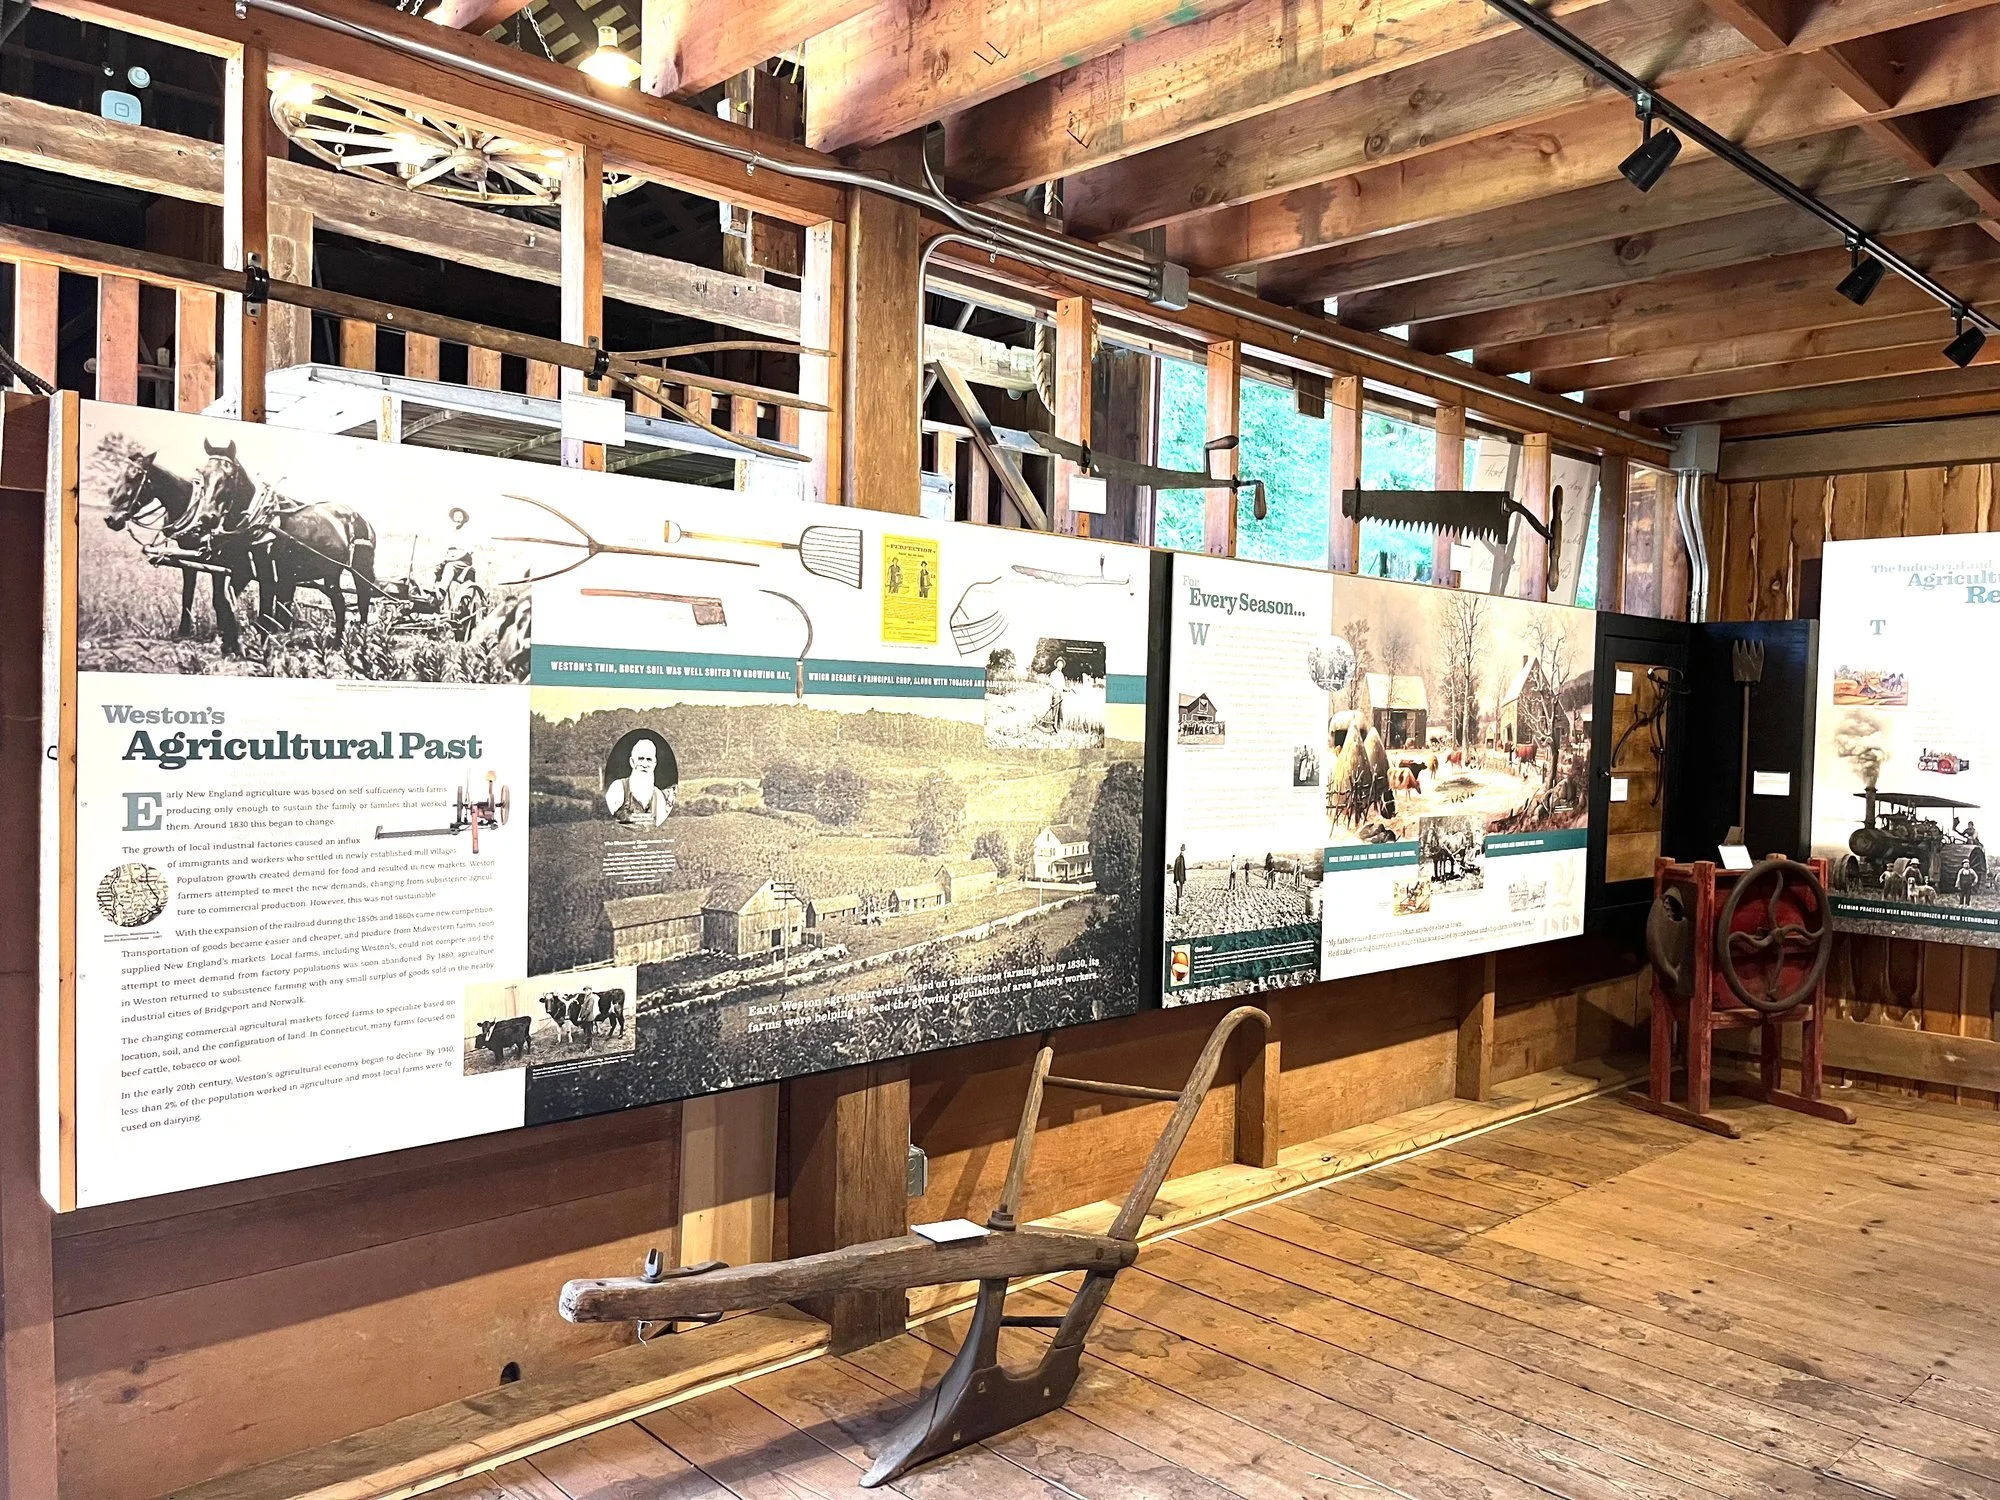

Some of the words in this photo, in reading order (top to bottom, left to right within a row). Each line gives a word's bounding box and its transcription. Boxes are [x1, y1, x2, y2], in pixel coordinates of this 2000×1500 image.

[1871, 565, 1895, 573] The
[1898, 561, 1964, 572] Industrial
[1183, 576, 1200, 586] For
[1190, 587, 1237, 615] Every
[1239, 592, 1305, 616] Season...
[1188, 622, 1210, 646] W
[1870, 620, 1886, 635] T
[551, 661, 592, 672] WESTON'S
[594, 663, 617, 674] THIN,
[620, 664, 644, 674] ROCKY
[647, 665, 664, 675] SOIL
[666, 666, 682, 676] WAS
[684, 666, 702, 676] WELL
[704, 668, 730, 678] SUITED
[732, 669, 742, 678] TO
[744, 670, 774, 680] GROWING
[808, 672, 830, 681] WHICH
[831, 673, 856, 682] BECAME
[858, 674, 862, 682] A
[863, 674, 894, 684] PRINCIPAL
[896, 676, 912, 685] CROP,
[914, 677, 932, 686] ALONG
[934, 678, 948, 686] WITH
[949, 678, 972, 687] TOBACCO
[974, 679, 984, 688] AND
[102, 704, 225, 725] Weston's
[122, 730, 394, 770] Agricultural
[399, 732, 482, 760] Past
[208, 790, 243, 798] England
[122, 792, 162, 831] E
[166, 807, 211, 815] producing
[236, 805, 268, 813] enough
[332, 802, 356, 810] family
[194, 821, 226, 829] Around
[268, 820, 292, 828] began
[143, 845, 174, 854] growth
[294, 838, 323, 846] caused
[176, 876, 223, 884] Population
[226, 873, 256, 882] growth
[214, 888, 259, 896] attempted
[208, 904, 258, 912] commercial
[1860, 905, 1885, 914] PRACTICES
[1900, 910, 1940, 920] REVOLUTIONIZED
[1962, 916, 1998, 924] TECHNOLOGIES
[214, 926, 258, 934] expansion
[284, 920, 315, 928] railroad
[121, 947, 188, 957] Transportation
[202, 942, 227, 952] goods
[122, 964, 160, 974] supplied
[186, 958, 228, 968] England's
[270, 952, 292, 960] Local
[323, 947, 359, 955] including
[121, 982, 158, 990] attempt
[198, 973, 234, 982] demand
[293, 964, 340, 974] populations
[748, 1003, 779, 1016] Early
[782, 999, 821, 1012] Weston
[824, 990, 882, 1006] agriculture
[883, 986, 904, 996] was
[906, 980, 934, 995] based
[936, 980, 948, 988] on
[950, 972, 1002, 986] subsistence
[1003, 966, 1038, 978] farming,
[1040, 964, 1055, 974] but
[1056, 962, 1066, 972] by
[1067, 958, 1088, 970] 1830,
[1089, 956, 1100, 966] its
[170, 991, 208, 1001] returned
[222, 986, 272, 995] subsistence
[346, 974, 366, 982] small
[748, 1020, 781, 1033] farms
[784, 1016, 812, 1028] were
[815, 1008, 854, 1022] helping
[857, 1006, 866, 1016] to
[870, 1002, 890, 1013] feed
[894, 1000, 910, 1010] the
[912, 993, 950, 1010] growing
[952, 983, 1000, 1001] population
[1002, 982, 1011, 992] of
[1012, 982, 1032, 992] area
[1034, 975, 1064, 988] factory
[1065, 972, 1098, 983] workers.
[121, 1012, 165, 1022] industrial
[204, 1004, 249, 1013] Bridgeport
[142, 1032, 183, 1042] changing
[186, 1025, 236, 1036] commercial
[240, 1019, 288, 1031] agricultural
[325, 1011, 350, 1019] forced
[121, 1052, 160, 1060] location,
[218, 1037, 275, 1048] configuration
[142, 1065, 170, 1074] cattle,
[172, 1062, 206, 1070] tobacco
[151, 1086, 174, 1094] early
[176, 1083, 195, 1091] 20th
[198, 1079, 233, 1088] century,
[235, 1072, 272, 1082] Weston's
[275, 1065, 321, 1078] agricultural
[324, 1061, 359, 1069] economy
[164, 1101, 177, 1109] 2%
[208, 1091, 254, 1103] population
[256, 1084, 287, 1094] worked
[300, 1078, 343, 1089] agriculture
[120, 1121, 147, 1131] cused
